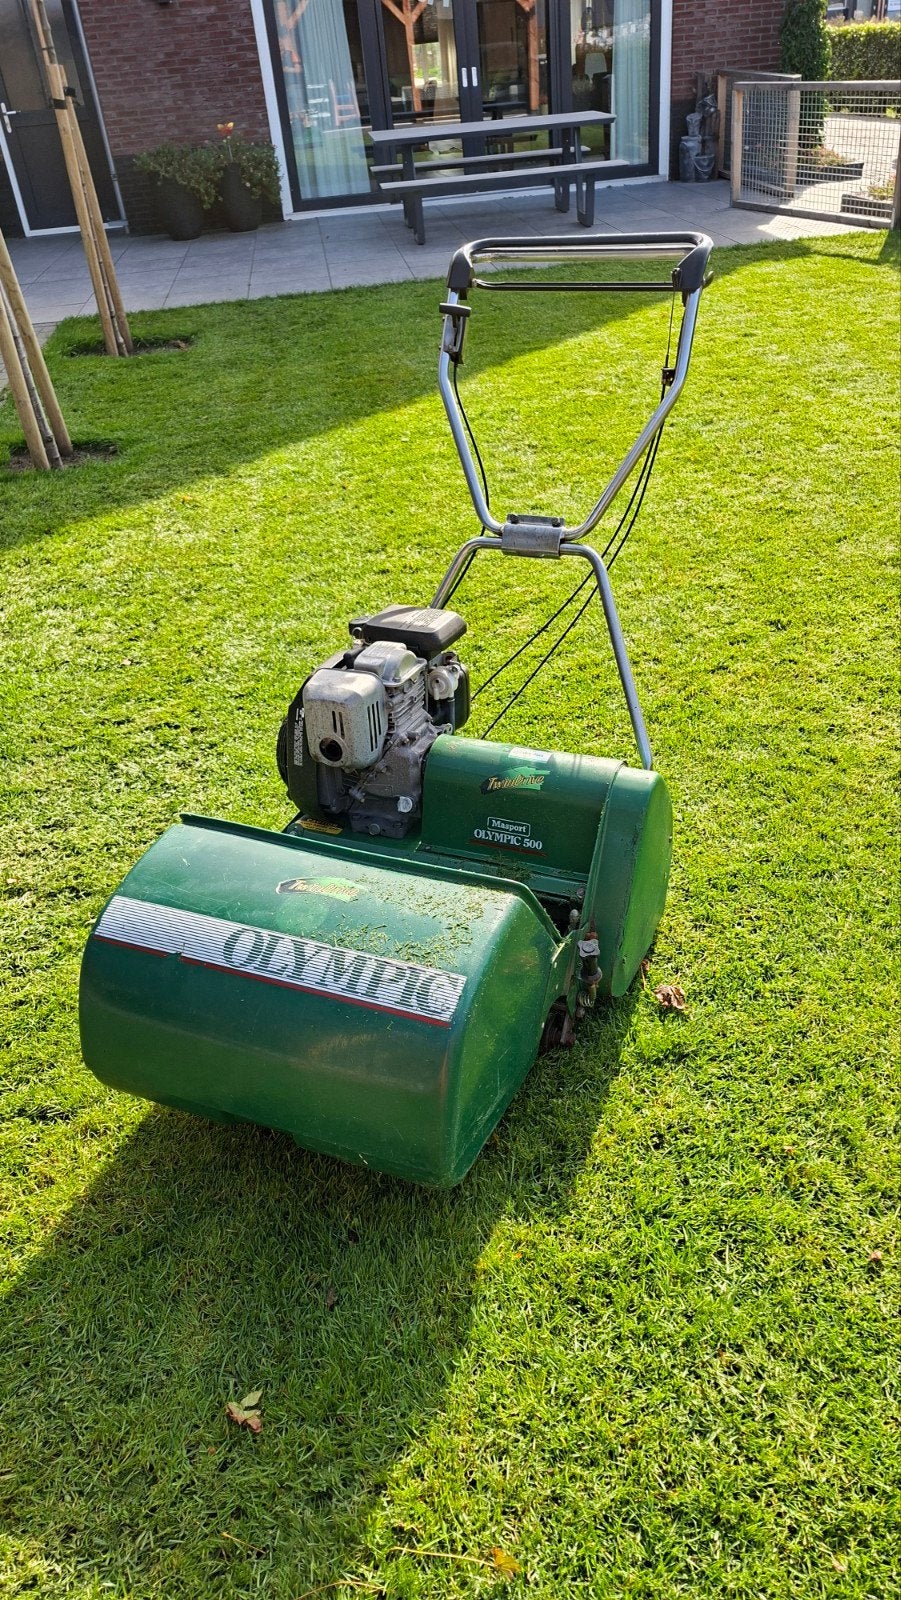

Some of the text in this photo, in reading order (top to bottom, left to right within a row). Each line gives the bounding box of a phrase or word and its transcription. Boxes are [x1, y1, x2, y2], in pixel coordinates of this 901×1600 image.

[491, 819, 528, 833] Masport
[473, 828, 543, 850] OLYMPIC 500
[222, 927, 461, 1015] OLYMPIC
